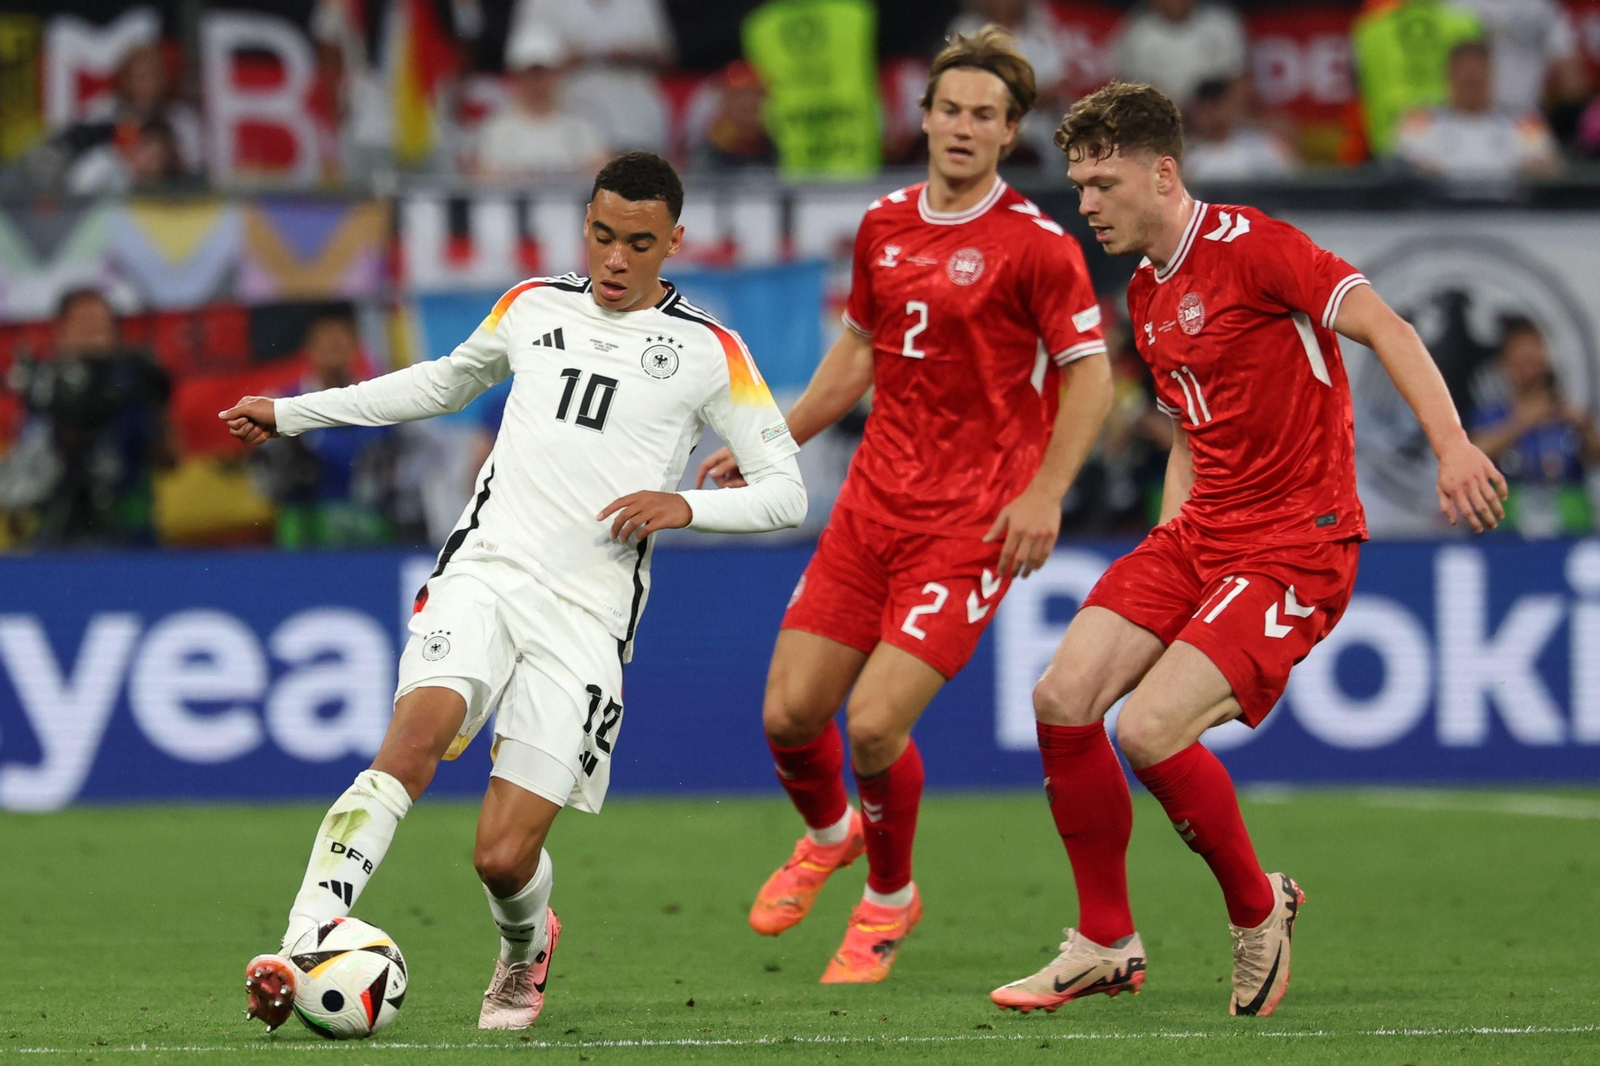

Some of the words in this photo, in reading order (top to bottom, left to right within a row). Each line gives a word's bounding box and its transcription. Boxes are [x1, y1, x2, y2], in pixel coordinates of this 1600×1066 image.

[902, 300, 928, 359] 2
[555, 368, 620, 434] 10
[1170, 365, 1212, 427] 11
[900, 581, 949, 641] 2
[0, 555, 436, 813] yea
[330, 841, 373, 875] DFB
